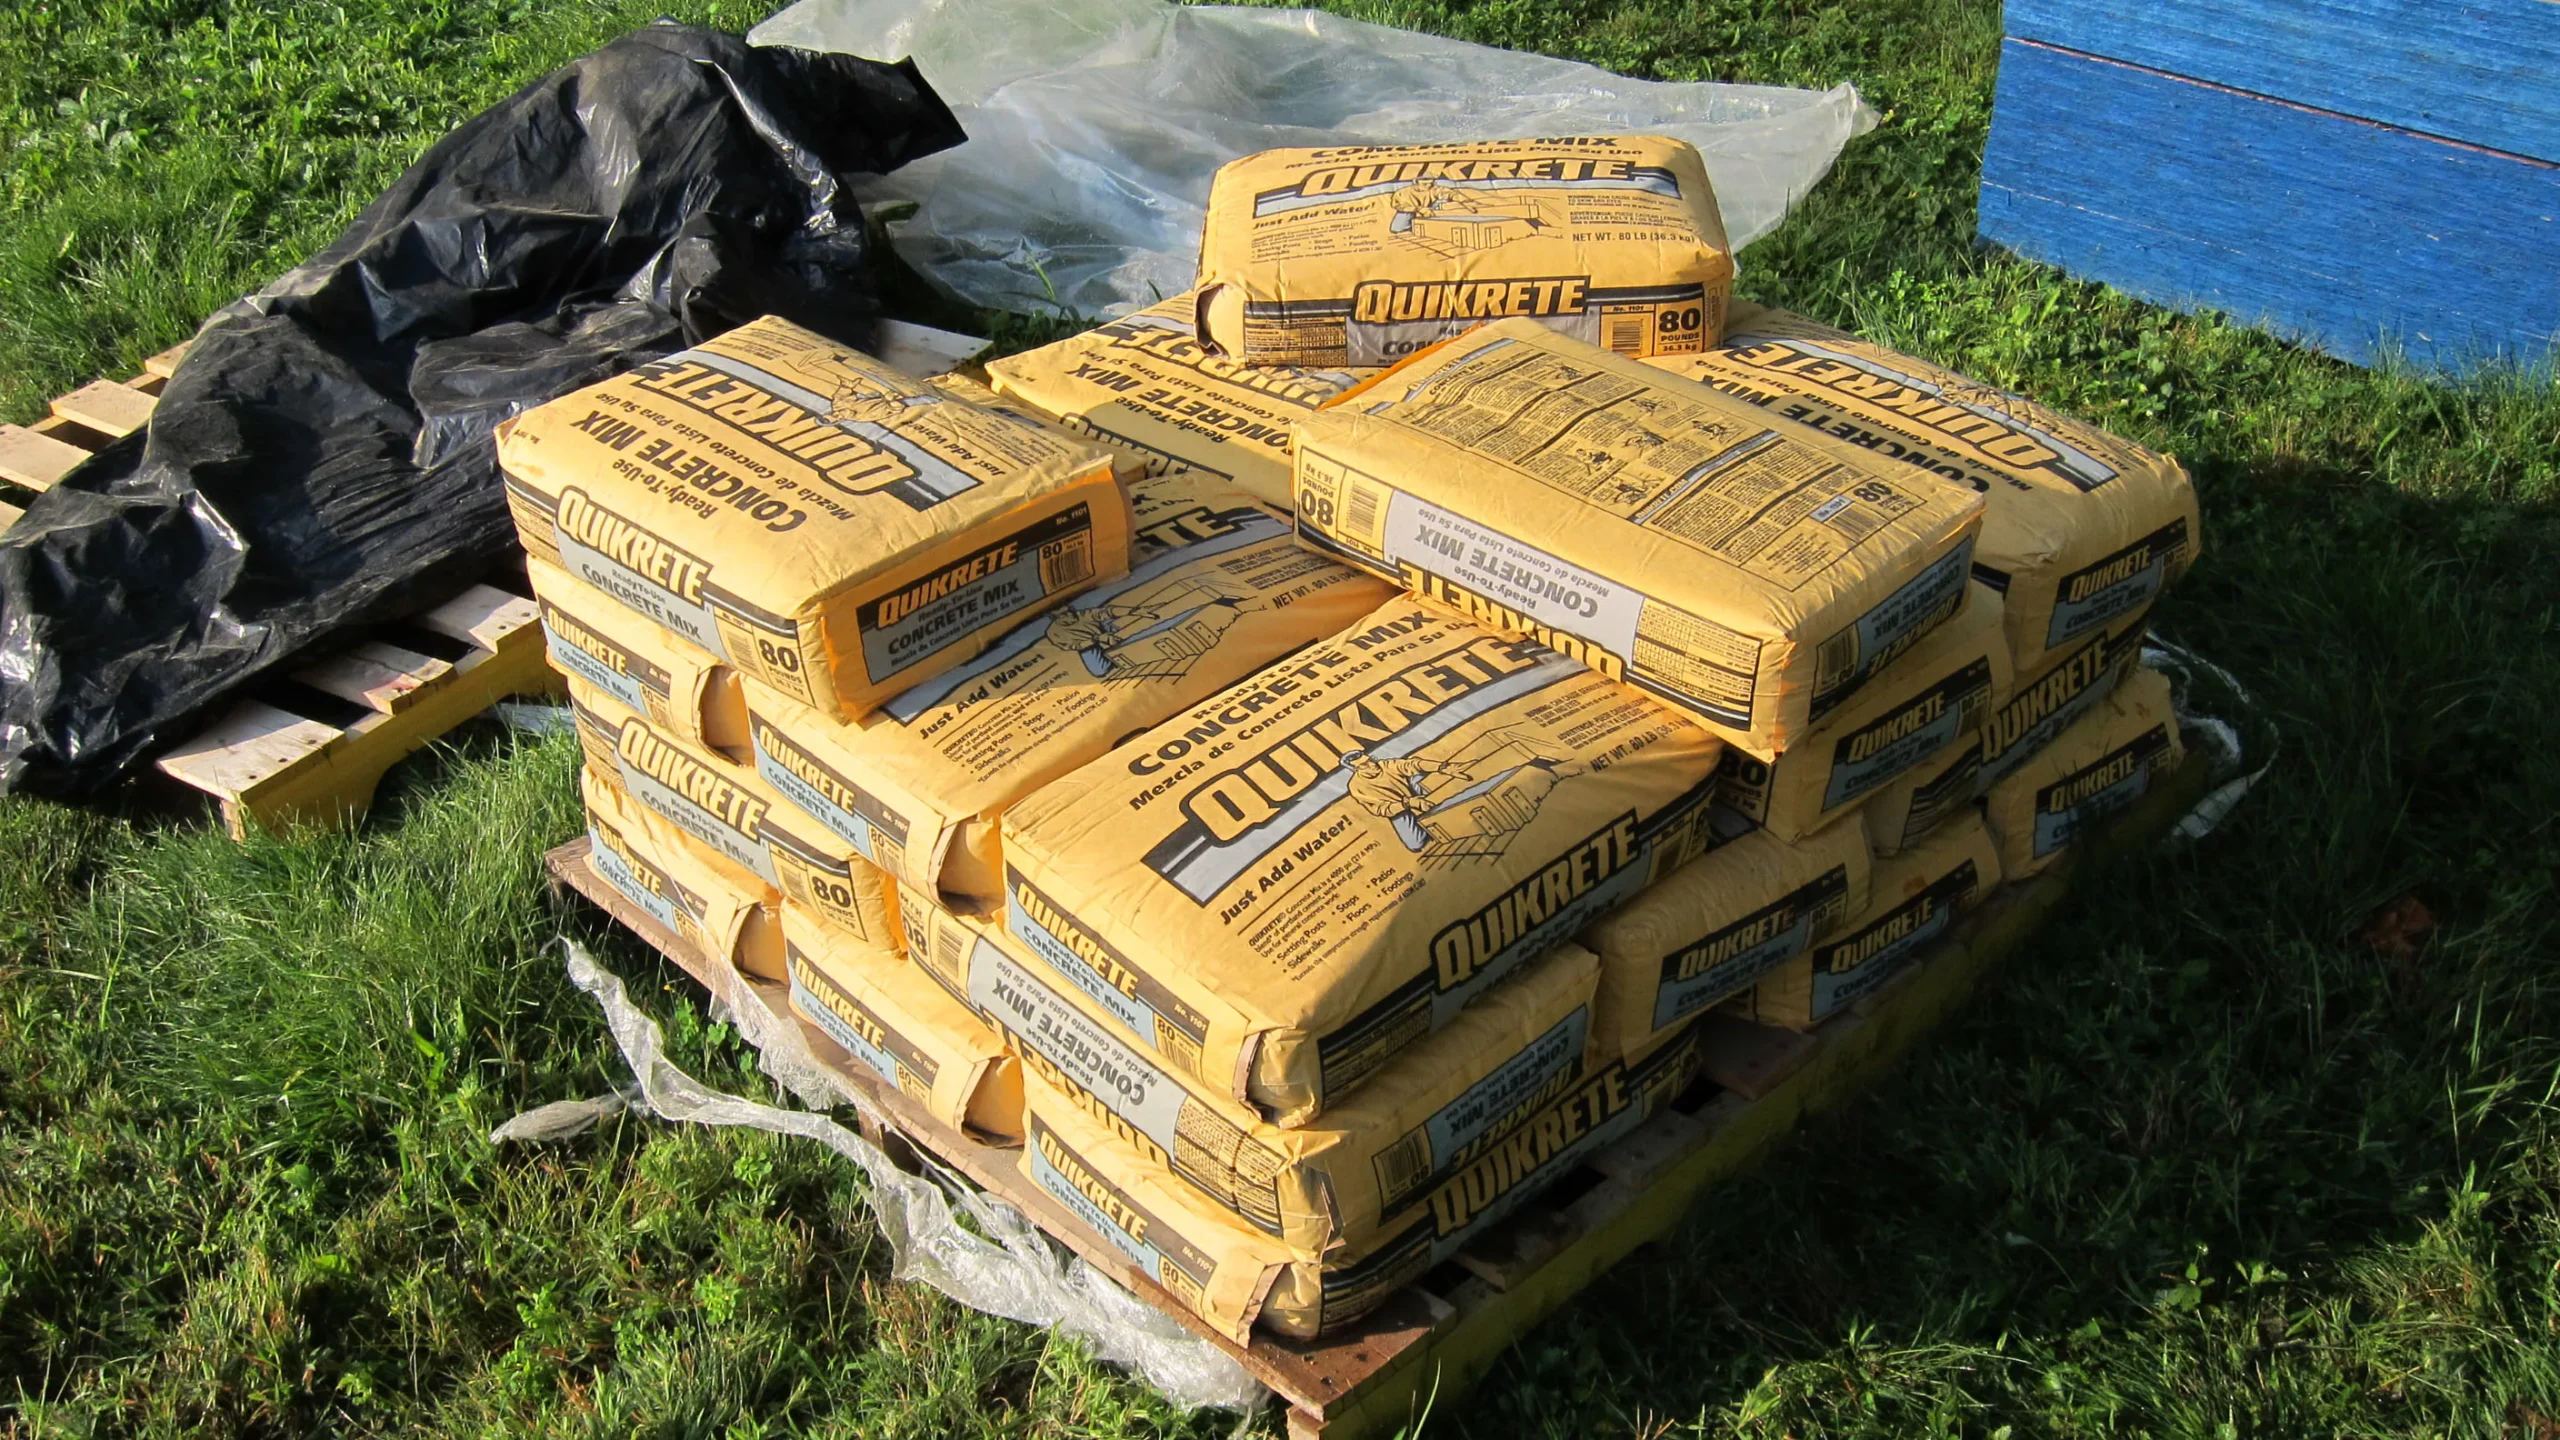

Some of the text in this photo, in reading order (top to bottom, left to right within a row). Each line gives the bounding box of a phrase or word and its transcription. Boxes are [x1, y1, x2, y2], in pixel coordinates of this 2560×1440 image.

[1285, 157, 1350, 169] Mezcla
[1358, 153, 1380, 161] de
[1387, 149, 1470, 159] Concreto
[1476, 147, 1521, 155] Lista
[1535, 136, 1619, 147] MIX
[1298, 159, 1635, 197] QUIKRETE
[1252, 202, 1375, 230] Just Add Water!
[1572, 232, 1676, 243] NET WT. 80 LB (36.3
[1354, 277, 1588, 325] QUIKRETE
[1658, 307, 1700, 333] 80
[1660, 332, 1700, 342] POUNDS
[1065, 362, 1143, 392] MIX
[1129, 363, 1274, 419] Concreto Lista Para
[1700, 374, 1780, 408] MIX
[1724, 343, 2060, 468] QUIKRETE
[570, 410, 648, 452] MIX
[632, 360, 918, 495] QUIKRETE
[900, 420, 1006, 477] Just Add Water!
[1115, 396, 1230, 444] Ready-To-Use
[1695, 359, 2034, 491] Mezcla de Concreto Lista Para Uso
[1778, 403, 1990, 493] CONCRETE
[595, 392, 855, 521] Mezcla de Concreto Lista Para Su Uso
[636, 438, 807, 533] CONCRETE
[612, 458, 719, 520] Ready-To-Use
[1070, 506, 1088, 521] 1101
[1300, 488, 1335, 526] 80
[1302, 476, 1335, 499] POUNDS
[1853, 481, 1894, 503] 80
[557, 487, 712, 608] QUIKRETE
[1041, 540, 1063, 560] 80
[1414, 523, 1599, 620] CONCRETE MIX
[1418, 508, 1610, 599] Mezcla de Concreto Lista Para Su Uso
[2067, 545, 2152, 603] QUIKRETE
[582, 563, 701, 639] CONCRETE MIX
[877, 541, 1021, 630] QUIKRETE
[1272, 590, 1295, 609] NET
[1453, 565, 1537, 610] Ready-To-Use
[548, 606, 629, 679] QUIKRETE
[888, 578, 1020, 656] CONCRETE MIX
[758, 638, 799, 673] 80
[768, 665, 803, 684] POUNDS
[1192, 644, 1335, 721] Ready-To-Use
[919, 653, 1046, 741] Just Add Water!
[1065, 691, 1098, 714] Footings
[1127, 649, 1350, 777] CONCRETE
[1352, 609, 1439, 652] MIX
[1130, 629, 1445, 811] Mezcla de Concreto Lista Para Su
[1979, 632, 2108, 765] QUIKRETE
[1179, 635, 1541, 846] QUIKRETE
[1589, 730, 1659, 773] NET WT. 80 LB
[1848, 691, 1945, 764] QUIKRETE
[618, 717, 771, 844] QUIKRETE
[759, 724, 856, 816] QUIKRETE
[2050, 751, 2135, 813] QUIKRETE
[640, 789, 724, 847] CONCRETE
[767, 766, 858, 844] CONCRETE MIX
[870, 828, 886, 849] 80
[811, 875, 851, 908] 80
[1219, 814, 1354, 926] Just Add Water!
[1370, 867, 1396, 887] Patios
[1381, 871, 1414, 897] Footings
[1336, 894, 1359, 913] Steps
[1346, 902, 1372, 922] Floors
[1434, 810, 1640, 991] QUIKRETE
[1016, 881, 1139, 1002] QUIKRETE
[1277, 919, 1327, 961] Setting Posts
[1287, 937, 1326, 970] Sidewalks
[1677, 904, 1797, 982] QUIKRETE
[1830, 896, 1933, 974] QUIKRETE
[992, 977, 1036, 1022] MIX
[1023, 924, 1101, 998] CONCRETE
[1104, 995, 1137, 1026] MIX
[794, 956, 887, 1053] QUIKRETE
[996, 960, 1125, 1060] de Concreto Lista Para Uso
[1156, 1018, 1175, 1042] 80
[1174, 1002, 1207, 1032] No. 1101
[897, 1064, 912, 1087] 80
[1025, 1026, 1094, 1087] Ready-To-Use
[1037, 1012, 1146, 1106] CONCRETE
[1430, 1064, 1629, 1238] QUIKRETE
[1039, 1129, 1149, 1244] QUIKRETE
[1043, 1171, 1113, 1240] CONCRETE
[1162, 1261, 1180, 1284] 80
[1181, 1246, 1214, 1273] No. 1101
